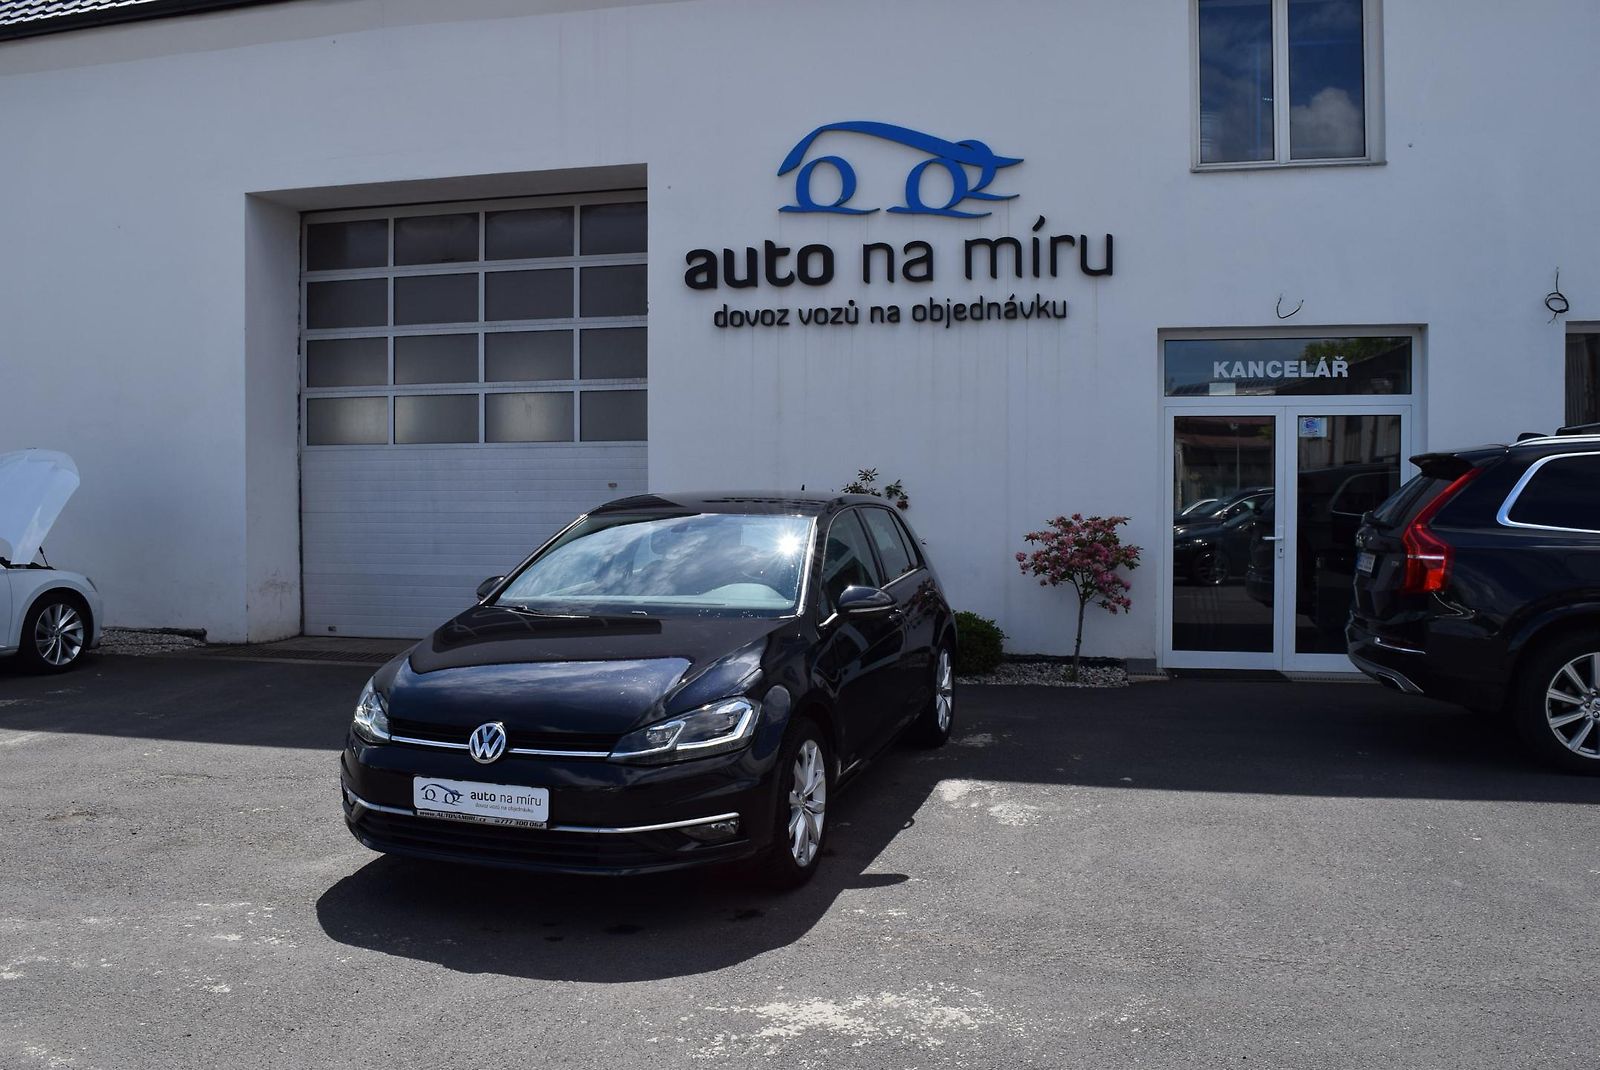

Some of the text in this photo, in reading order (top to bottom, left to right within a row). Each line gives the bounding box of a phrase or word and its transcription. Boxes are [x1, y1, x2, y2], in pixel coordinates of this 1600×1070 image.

[684, 214, 1115, 290] auto na míru
[713, 293, 1068, 328] dovoz vozů na objednávku
[1213, 356, 1349, 378] KANCELÁŘ
[470, 790, 542, 807] auto na míru
